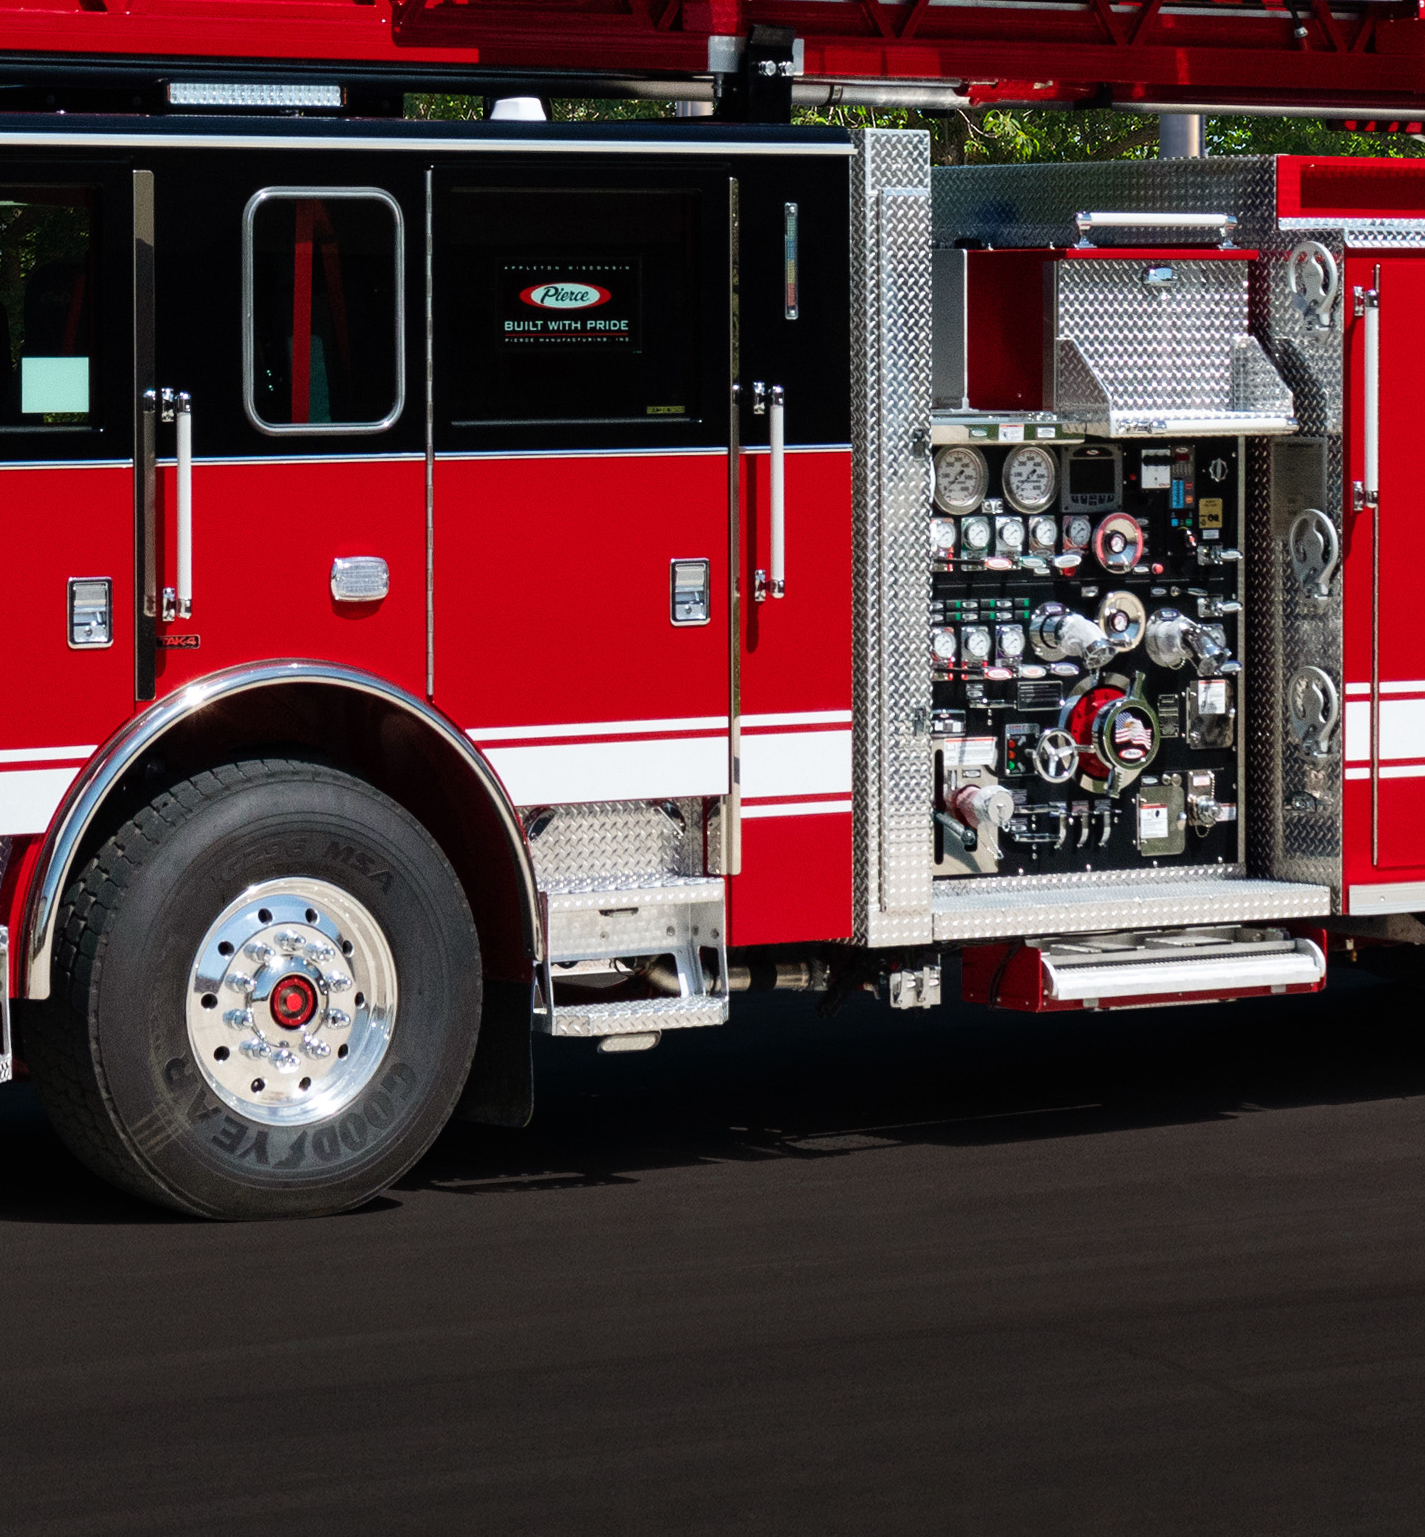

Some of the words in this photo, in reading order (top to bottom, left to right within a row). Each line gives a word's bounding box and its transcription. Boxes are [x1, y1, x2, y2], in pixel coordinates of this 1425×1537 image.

[540, 286, 589, 305] Pierce
[504, 321, 543, 331] BUILT
[548, 321, 581, 330] WITH
[587, 320, 629, 330] PRIDE
